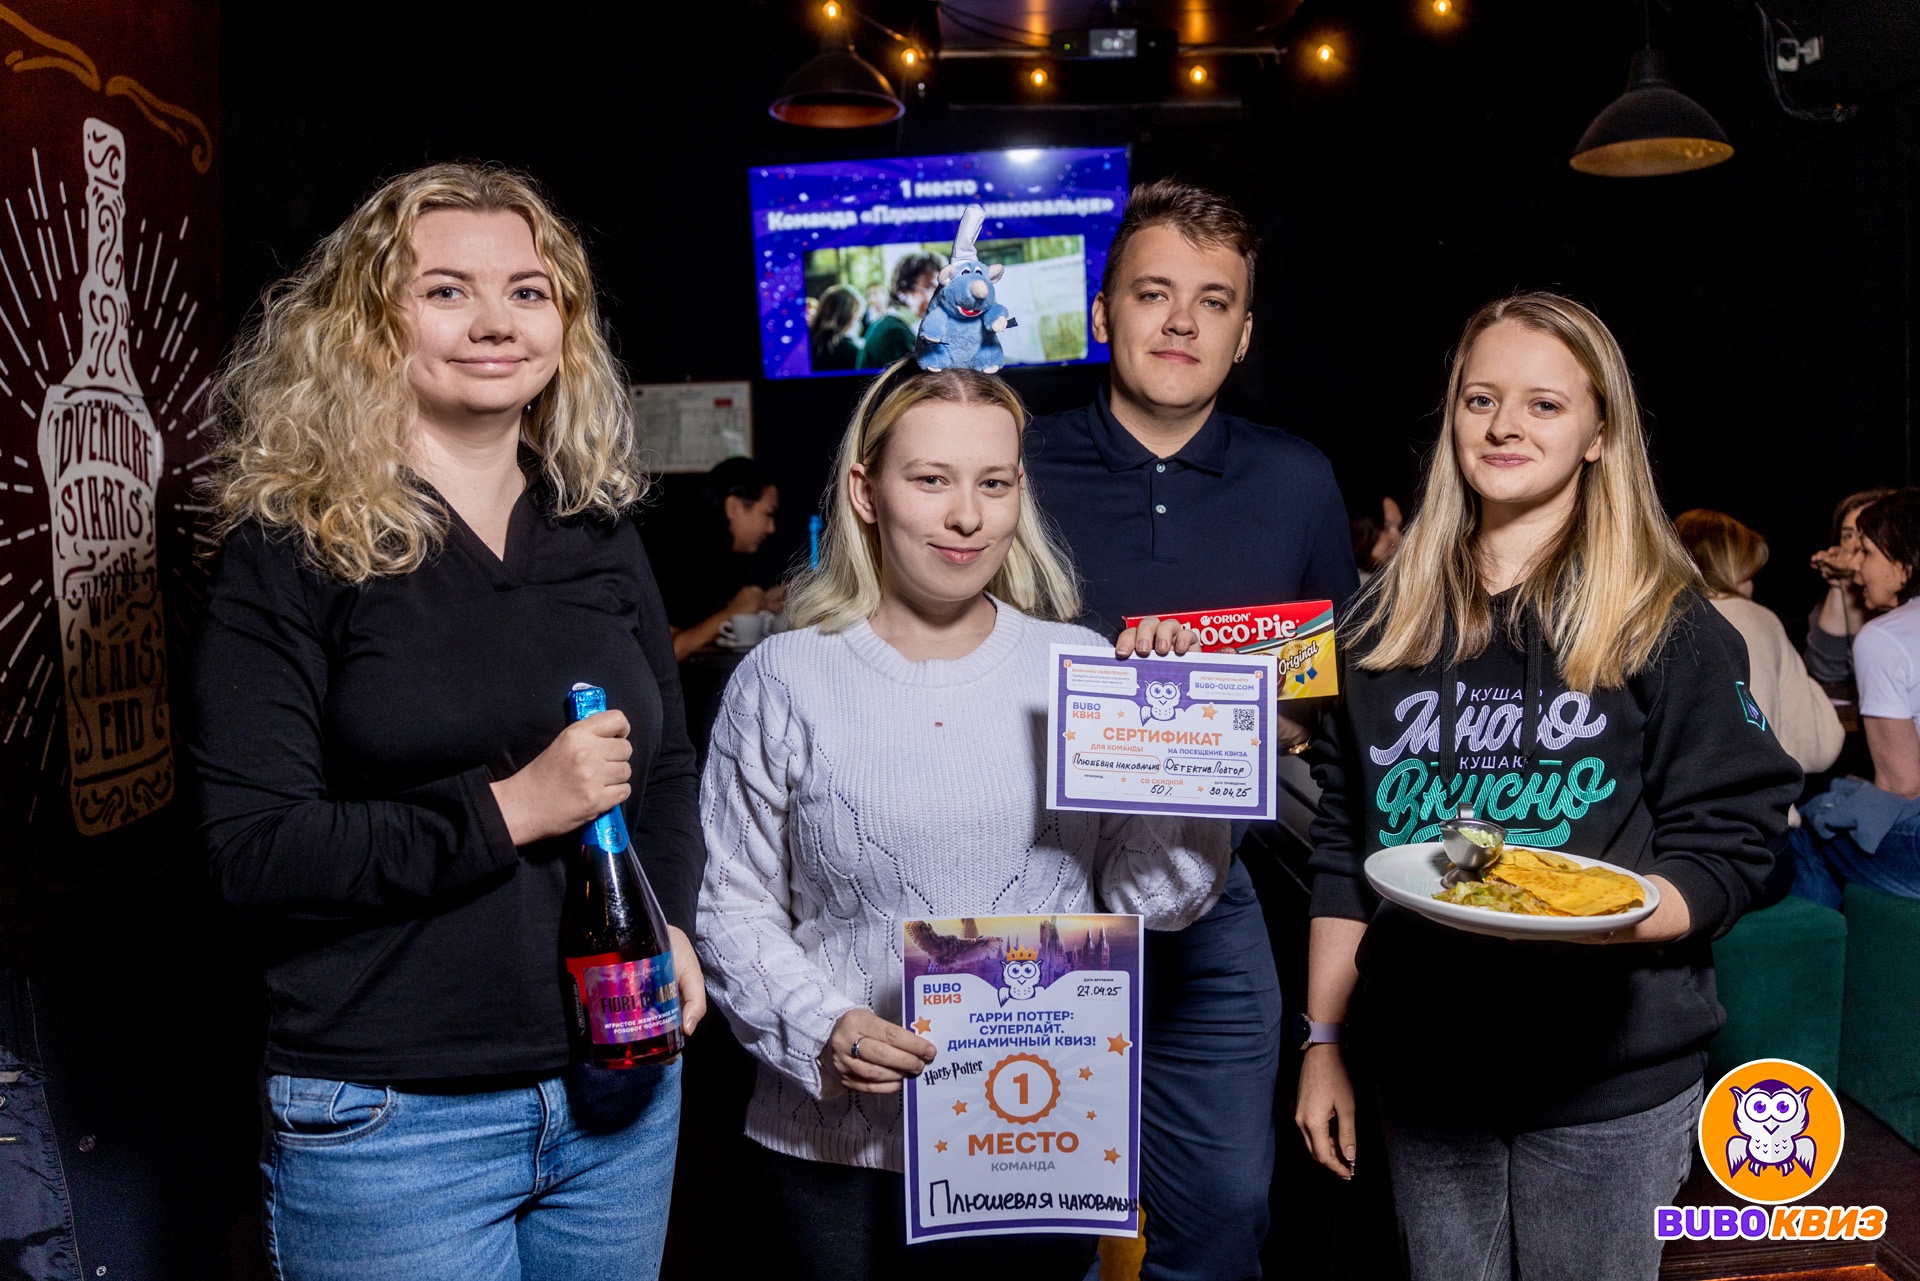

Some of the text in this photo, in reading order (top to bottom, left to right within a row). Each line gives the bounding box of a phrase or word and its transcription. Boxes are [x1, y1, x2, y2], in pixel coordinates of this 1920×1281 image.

[900, 179, 978, 199] 1 место
[767, 210, 858, 231] Команда
[61, 475, 143, 541] STARTS
[1213, 613, 1249, 624] ORION
[80, 622, 155, 697] PLANS
[1278, 640, 1319, 675] Original
[1195, 682, 1254, 691] BUBO-QUIZ.COM
[1470, 687, 1542, 702] КУША
[1072, 701, 1101, 711] BUBO
[1072, 711, 1101, 720] КВИЗ
[99, 698, 144, 760] END
[1103, 726, 1223, 746] СЕРТИФИКАТ
[1090, 743, 1144, 753] ДЛЯ КОМАНДЫ
[1179, 748, 1222, 757] ПОСЕЩЕНИЕ
[1151, 778, 1184, 786] СКИДКОЙ
[923, 982, 962, 994] BUBO
[1077, 985, 1122, 997] 27.04.25
[601, 993, 636, 1014] FIORI
[923, 993, 962, 1006] КВИЗ
[604, 1020, 636, 1029] ИГРИСТОЕ
[637, 1010, 671, 1024] ЖЕМЧУЖНОЕ
[969, 1010, 1074, 1024] ГАРРИ ПОТТЕР:
[613, 1025, 642, 1034] РОЗОВОЕ
[979, 1021, 1065, 1036] СУПЕРЛАЙТ.
[947, 1034, 1096, 1052] ДИНАМИЧНЫЙ КВИЗ!
[923, 1059, 983, 1086] Harry Potter
[1013, 1072, 1029, 1105] 1
[968, 1131, 1079, 1156] МЕСТО
[991, 1161, 1056, 1172] КОМАНДА
